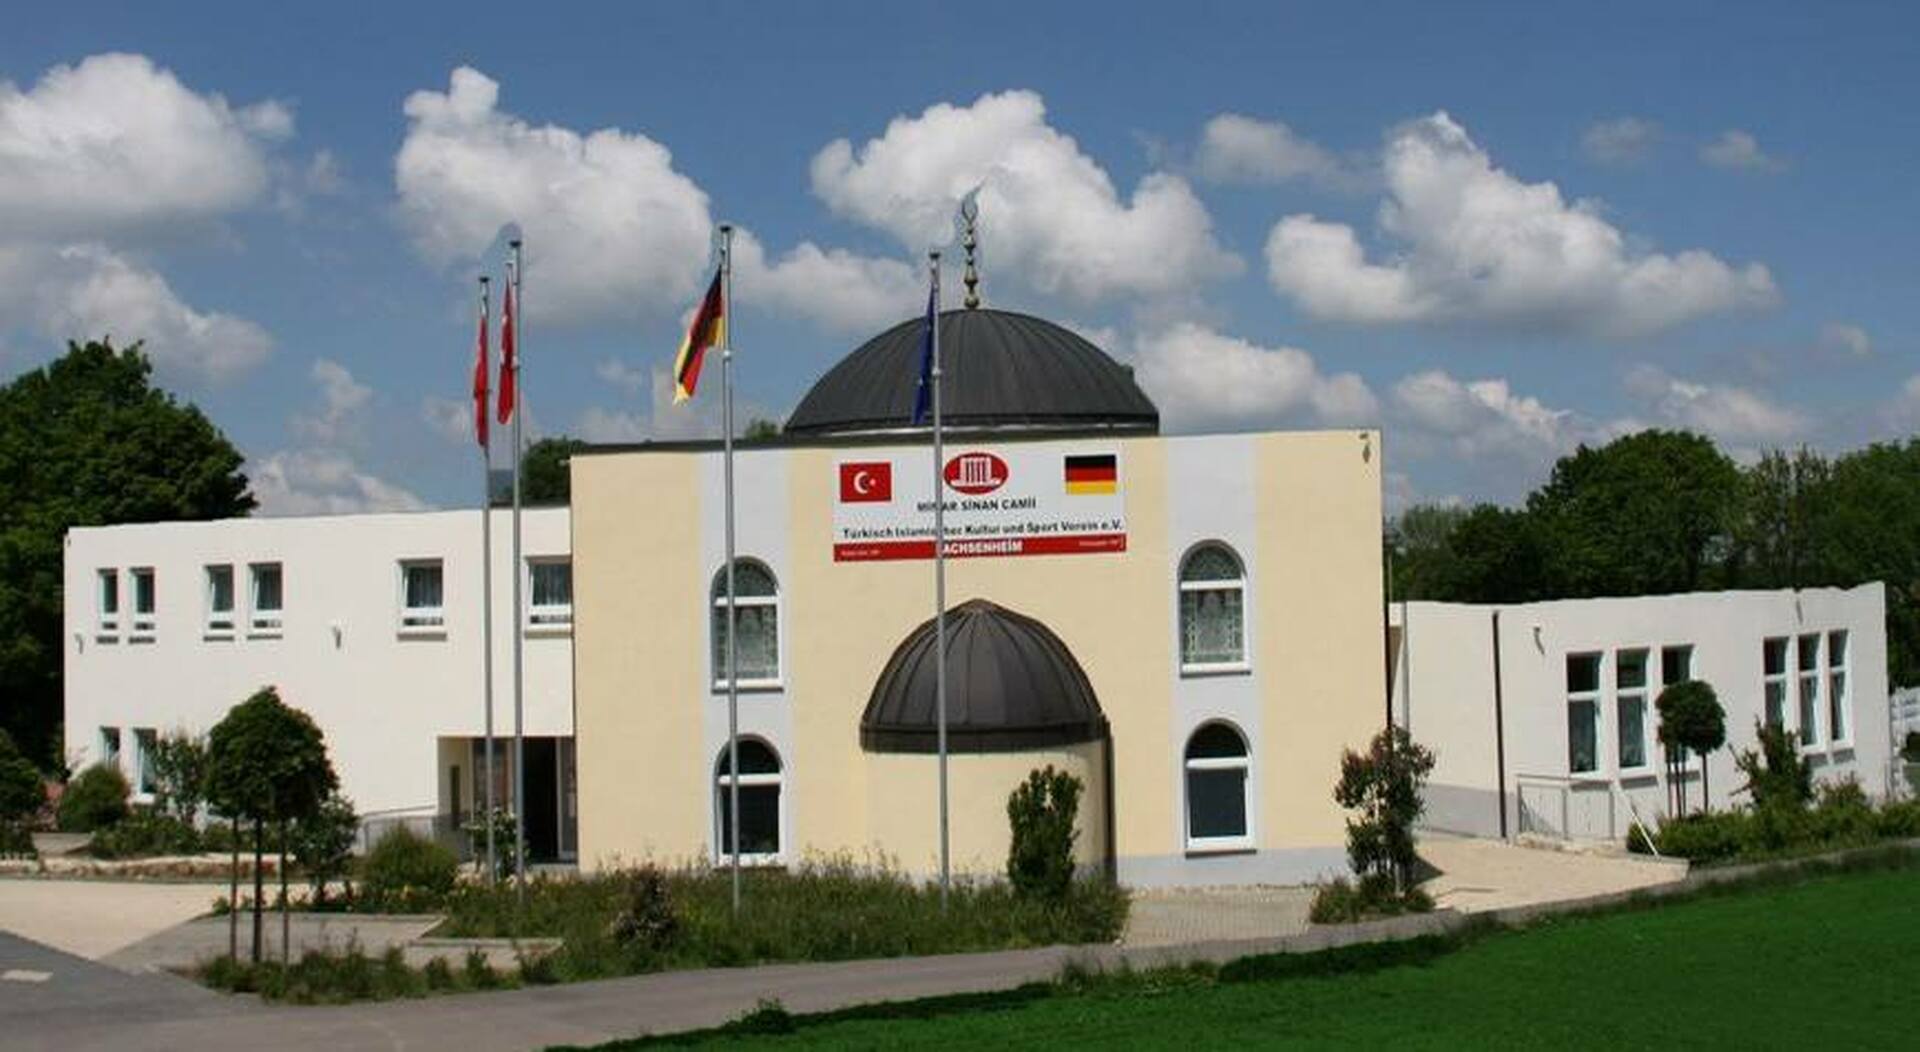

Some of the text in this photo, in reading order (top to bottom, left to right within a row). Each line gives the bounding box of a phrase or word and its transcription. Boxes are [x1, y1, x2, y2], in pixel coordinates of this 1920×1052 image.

[965, 524, 999, 535] Kultur
[1002, 523, 1025, 534] und
[1027, 521, 1058, 533] Sport
[1061, 520, 1098, 532] Verein
[1101, 518, 1123, 531] e.V.
